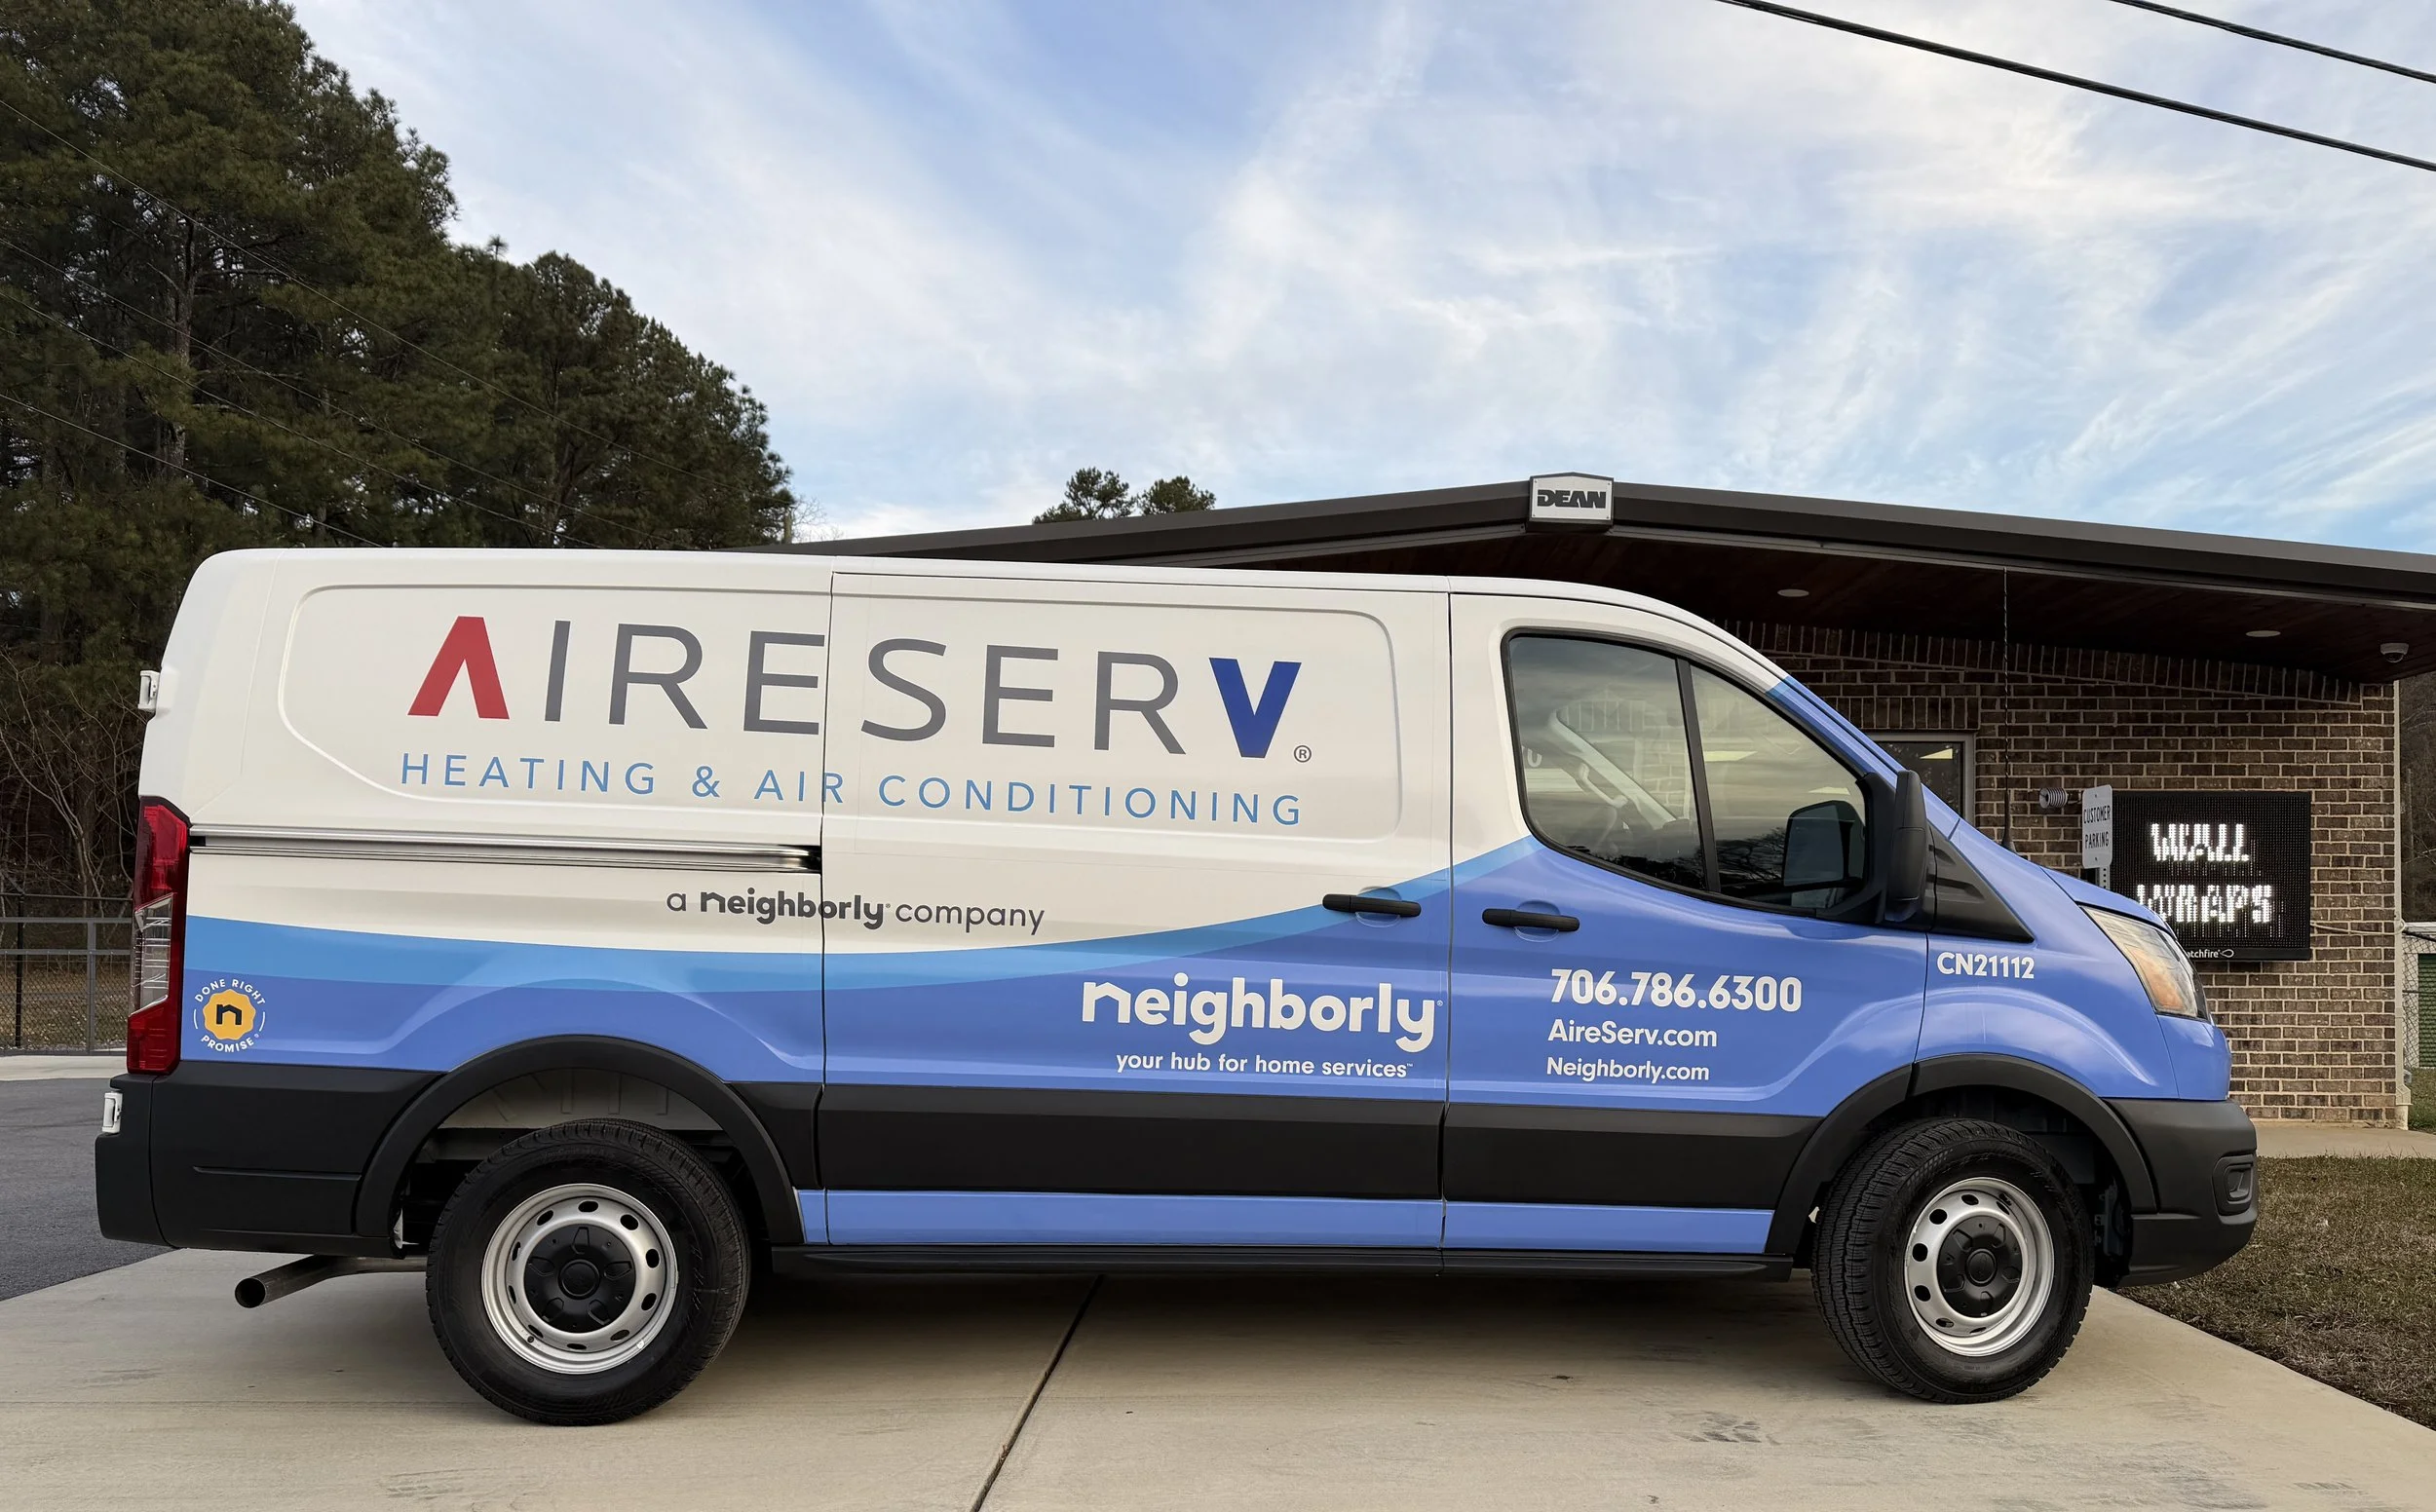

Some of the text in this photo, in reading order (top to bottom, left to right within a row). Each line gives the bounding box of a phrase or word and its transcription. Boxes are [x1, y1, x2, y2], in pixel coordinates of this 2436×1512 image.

[1537, 489, 1607, 509] DEAN
[407, 616, 1302, 758] AIRESERV
[401, 752, 1301, 825] HEATING & AIR CONDITIONING
[2083, 805, 2112, 824] CUSTOMER
[2085, 831, 2110, 850] PARKING
[666, 887, 1045, 935] a neighborly company
[1936, 952, 2036, 980] CN21112
[2187, 949, 2219, 958] tchfire
[195, 979, 266, 1004] DONE RIGHT
[1550, 968, 1803, 1012] 706.786.6300
[216, 1004, 242, 1025] n
[1082, 972, 1435, 1053] neighborly
[201, 1035, 254, 1052] PROMISE
[1547, 1019, 1718, 1047] AireServ.com
[1116, 1052, 1407, 1078] your hub for home services
[1546, 1056, 1710, 1084] Neighborly.com
